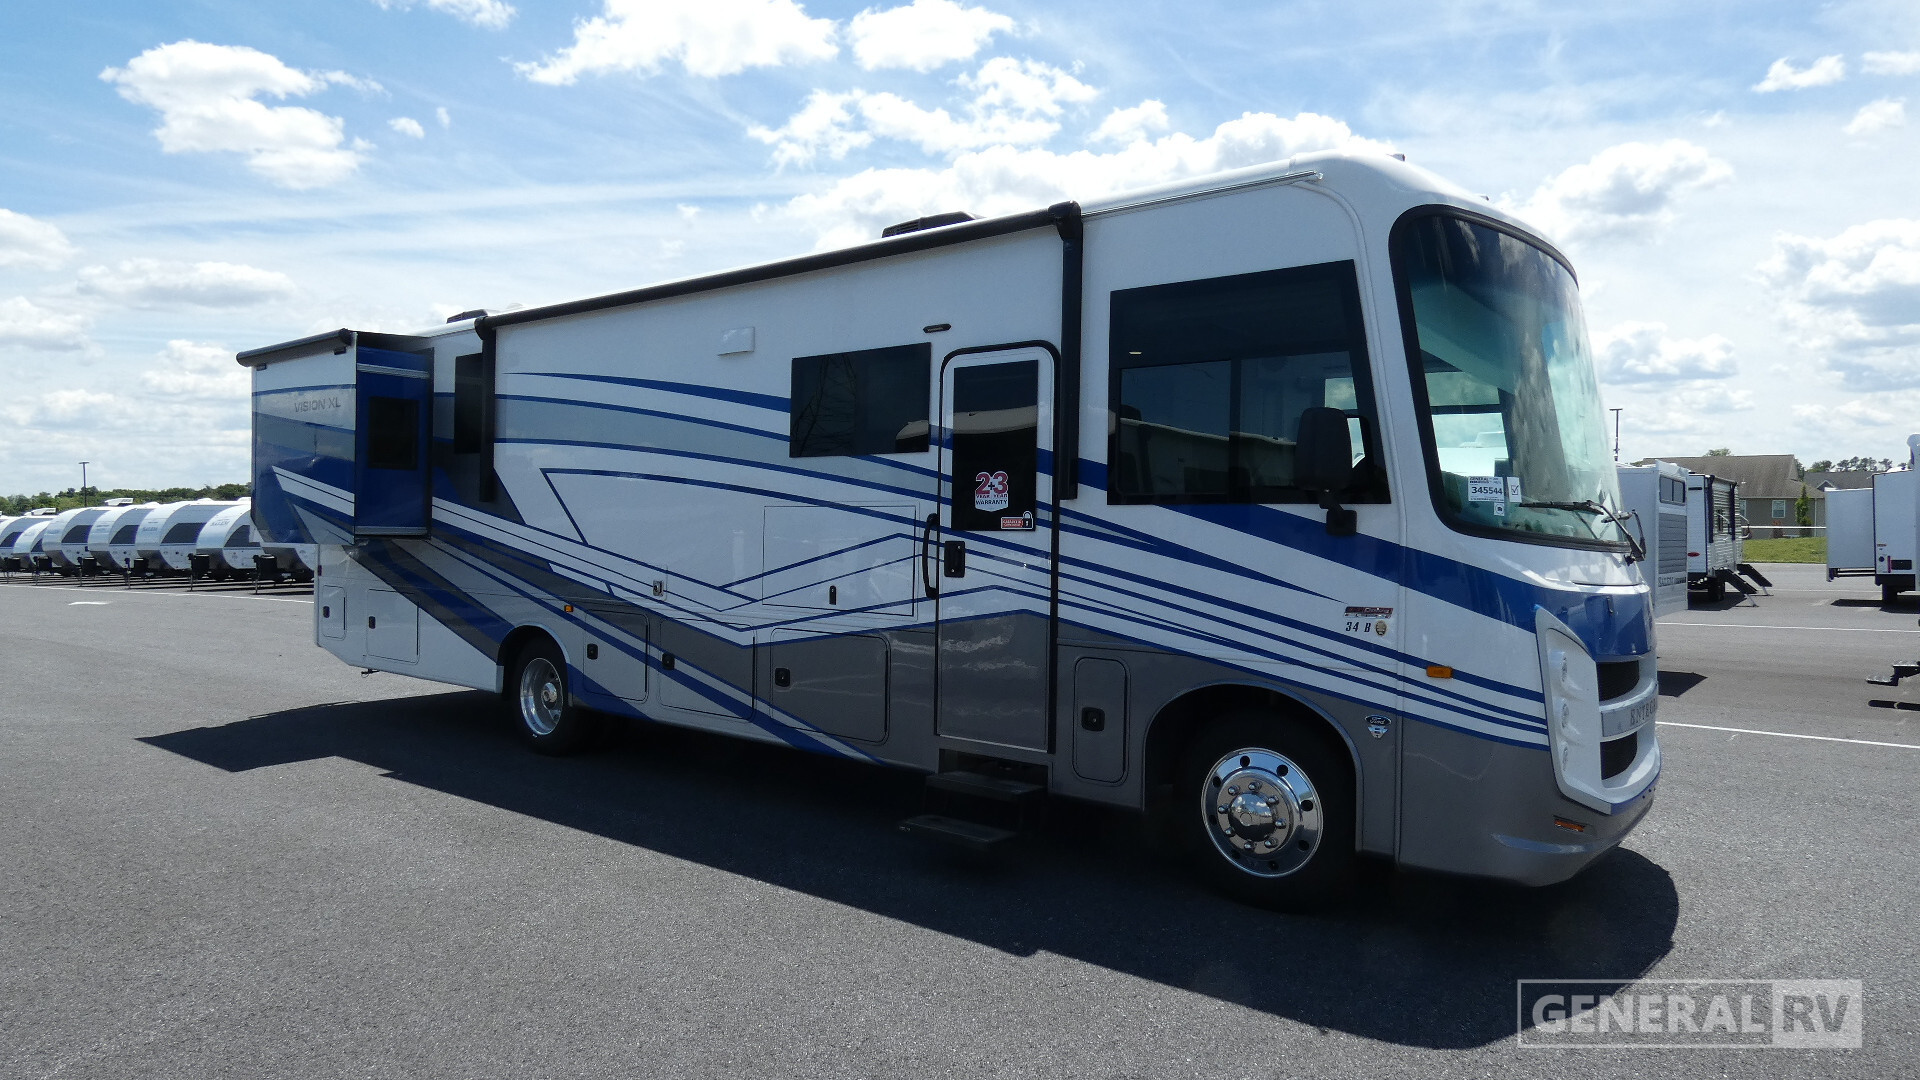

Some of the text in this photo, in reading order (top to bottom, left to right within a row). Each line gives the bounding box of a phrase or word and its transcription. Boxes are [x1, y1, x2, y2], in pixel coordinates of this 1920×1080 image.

[294, 397, 341, 412] VISION XL
[1471, 486, 1503, 494] 345544
[1345, 621, 1371, 632] 34 B
